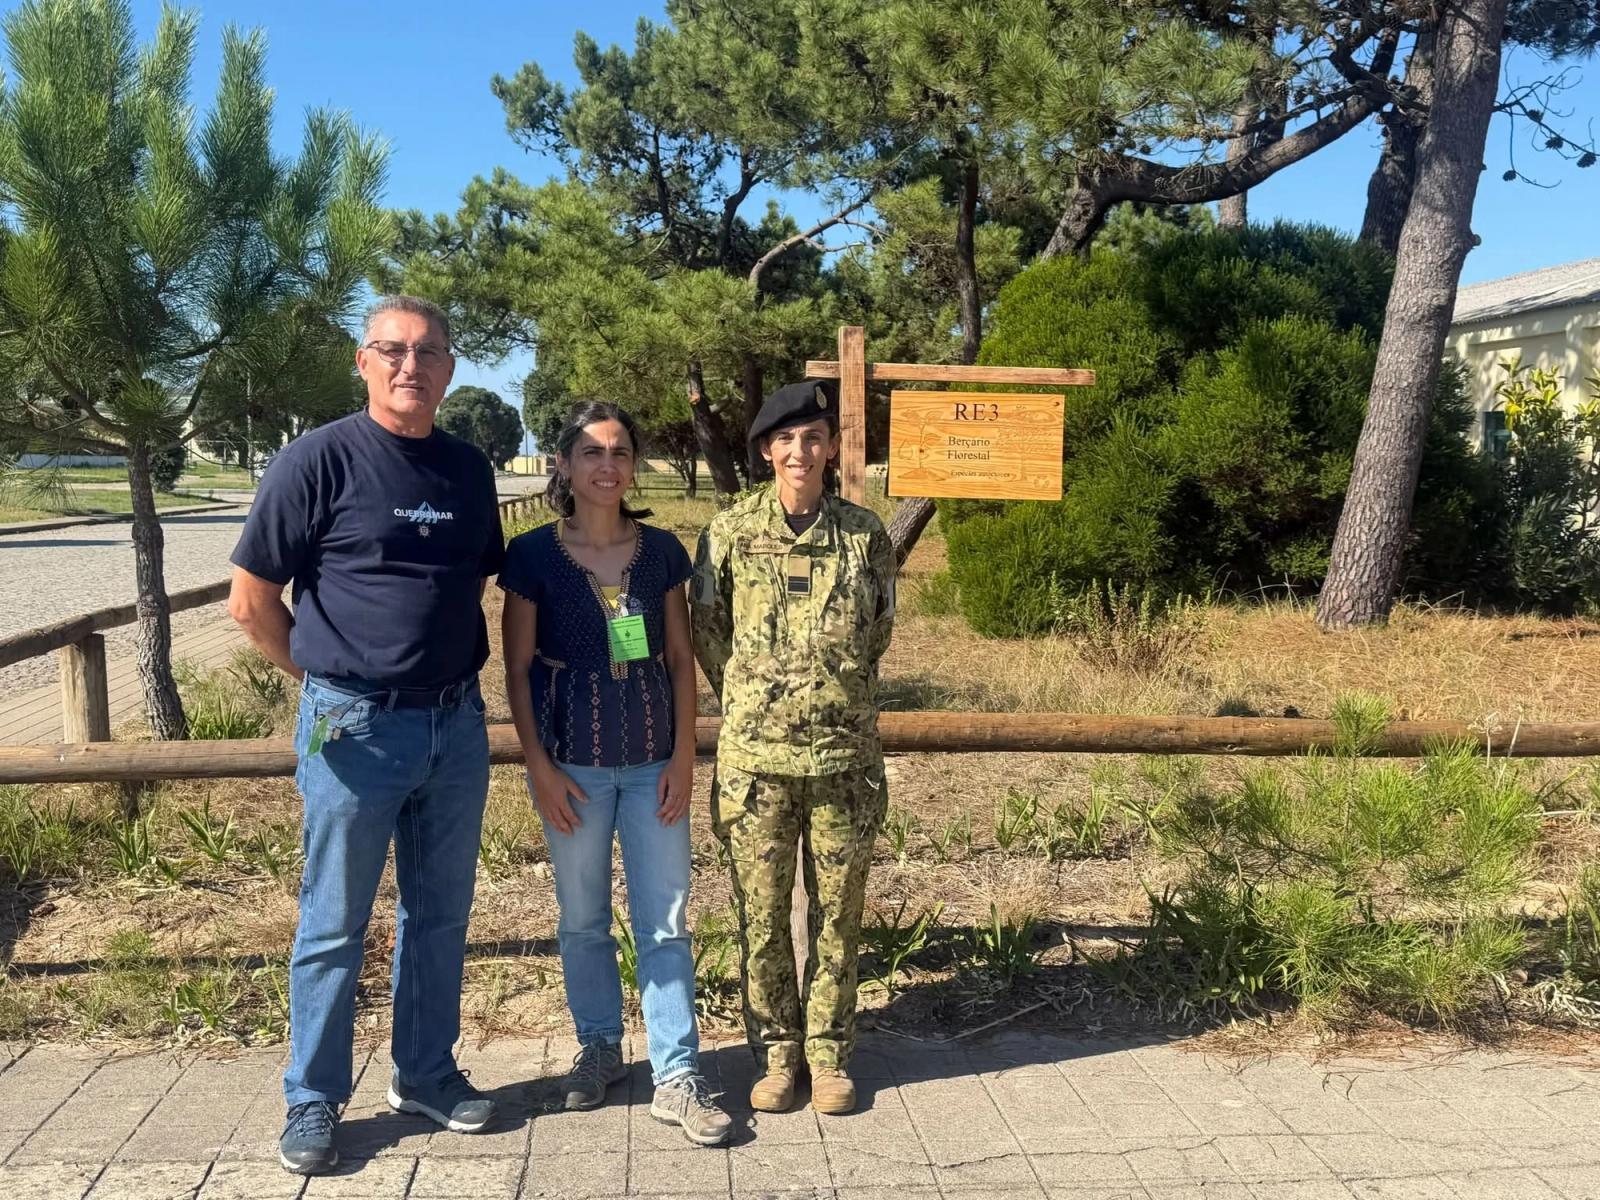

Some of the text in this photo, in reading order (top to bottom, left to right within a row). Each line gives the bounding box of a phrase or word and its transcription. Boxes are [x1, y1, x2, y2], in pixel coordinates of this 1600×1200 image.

[954, 403, 999, 421] RE3
[947, 450, 990, 460] Florestal
[393, 508, 454, 520] QUEBRAMAR
